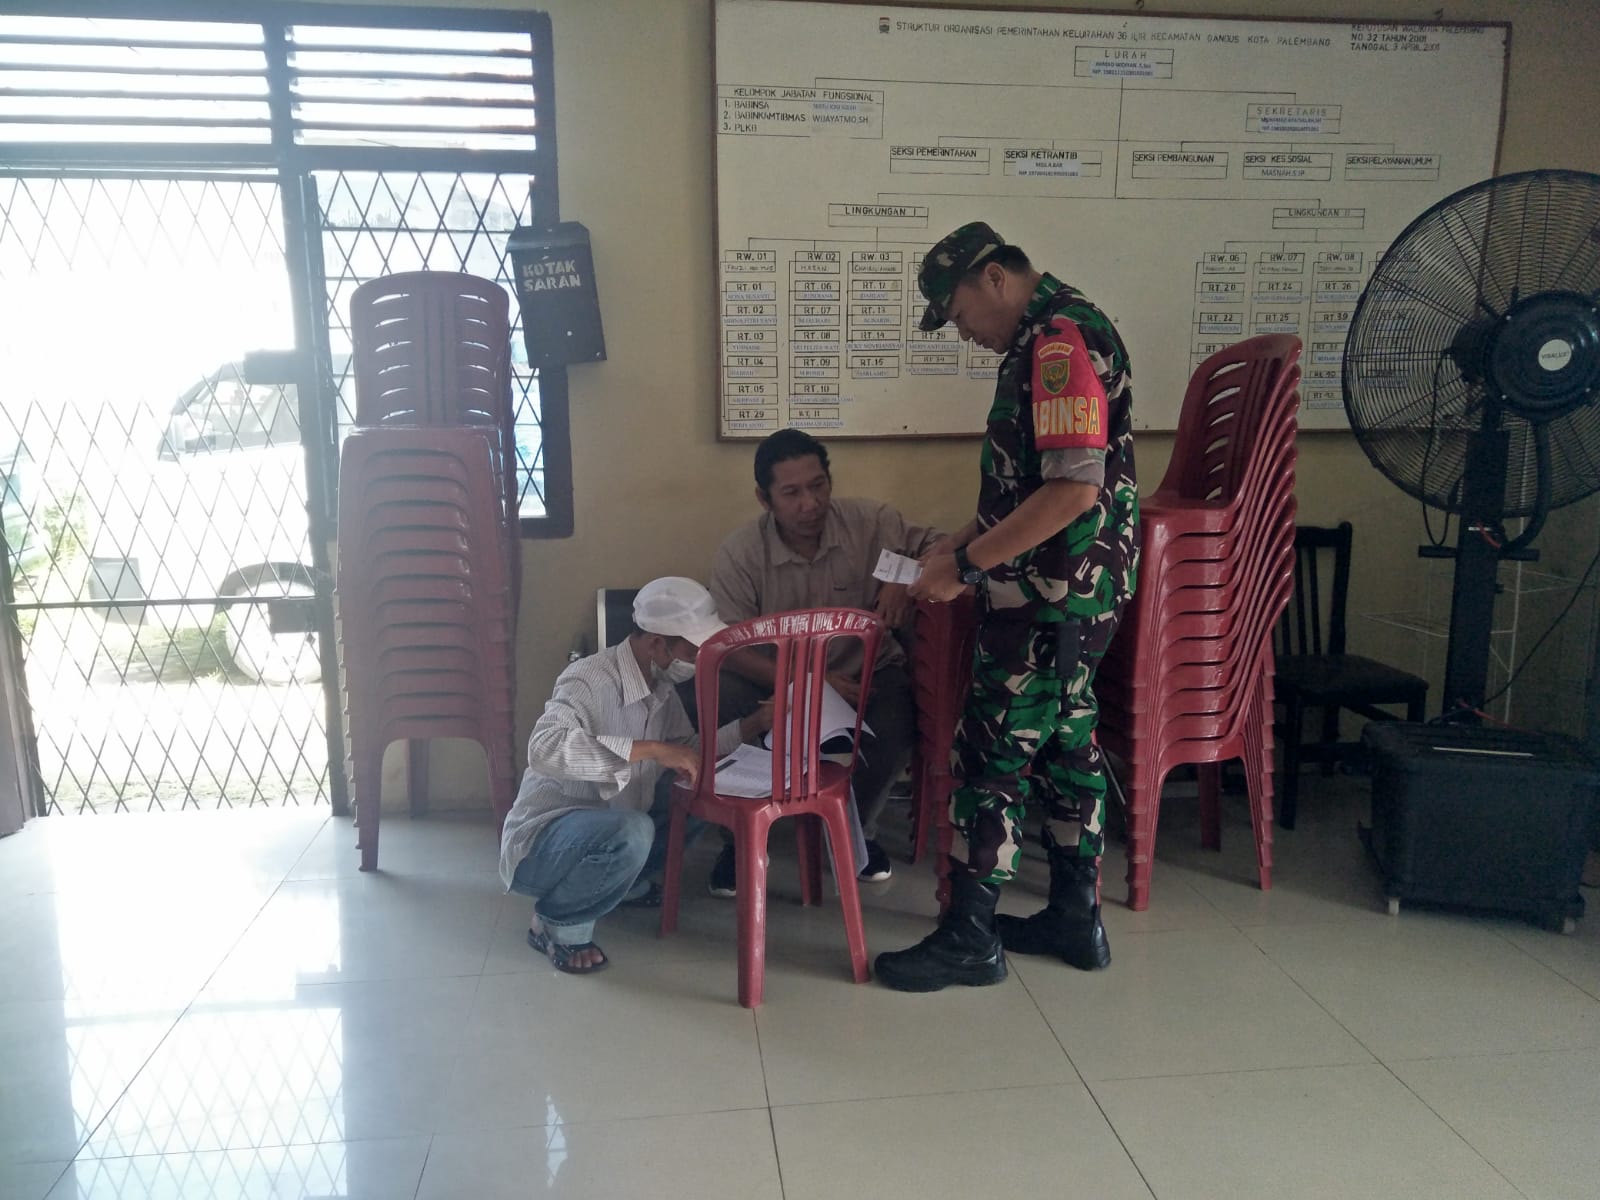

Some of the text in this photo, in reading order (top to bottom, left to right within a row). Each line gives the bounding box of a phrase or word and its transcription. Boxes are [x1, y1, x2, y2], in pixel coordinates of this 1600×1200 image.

[896, 21, 940, 32] STRUKTUR
[1248, 35, 1270, 44] KOTA
[1381, 34, 1407, 42] TAHUN
[734, 88, 873, 102] KELOMPOK JABATAN FUNGSIONAL
[891, 148, 977, 158] SEKSI PEMERINTAHAN
[1005, 150, 1028, 159] SEKSI
[1134, 153, 1155, 162] SEKSI
[1244, 155, 1266, 164] SEKSI
[845, 206, 906, 217] LINGKUNGAN
[522, 259, 576, 278] KOTAK
[523, 274, 581, 292] SARAN
